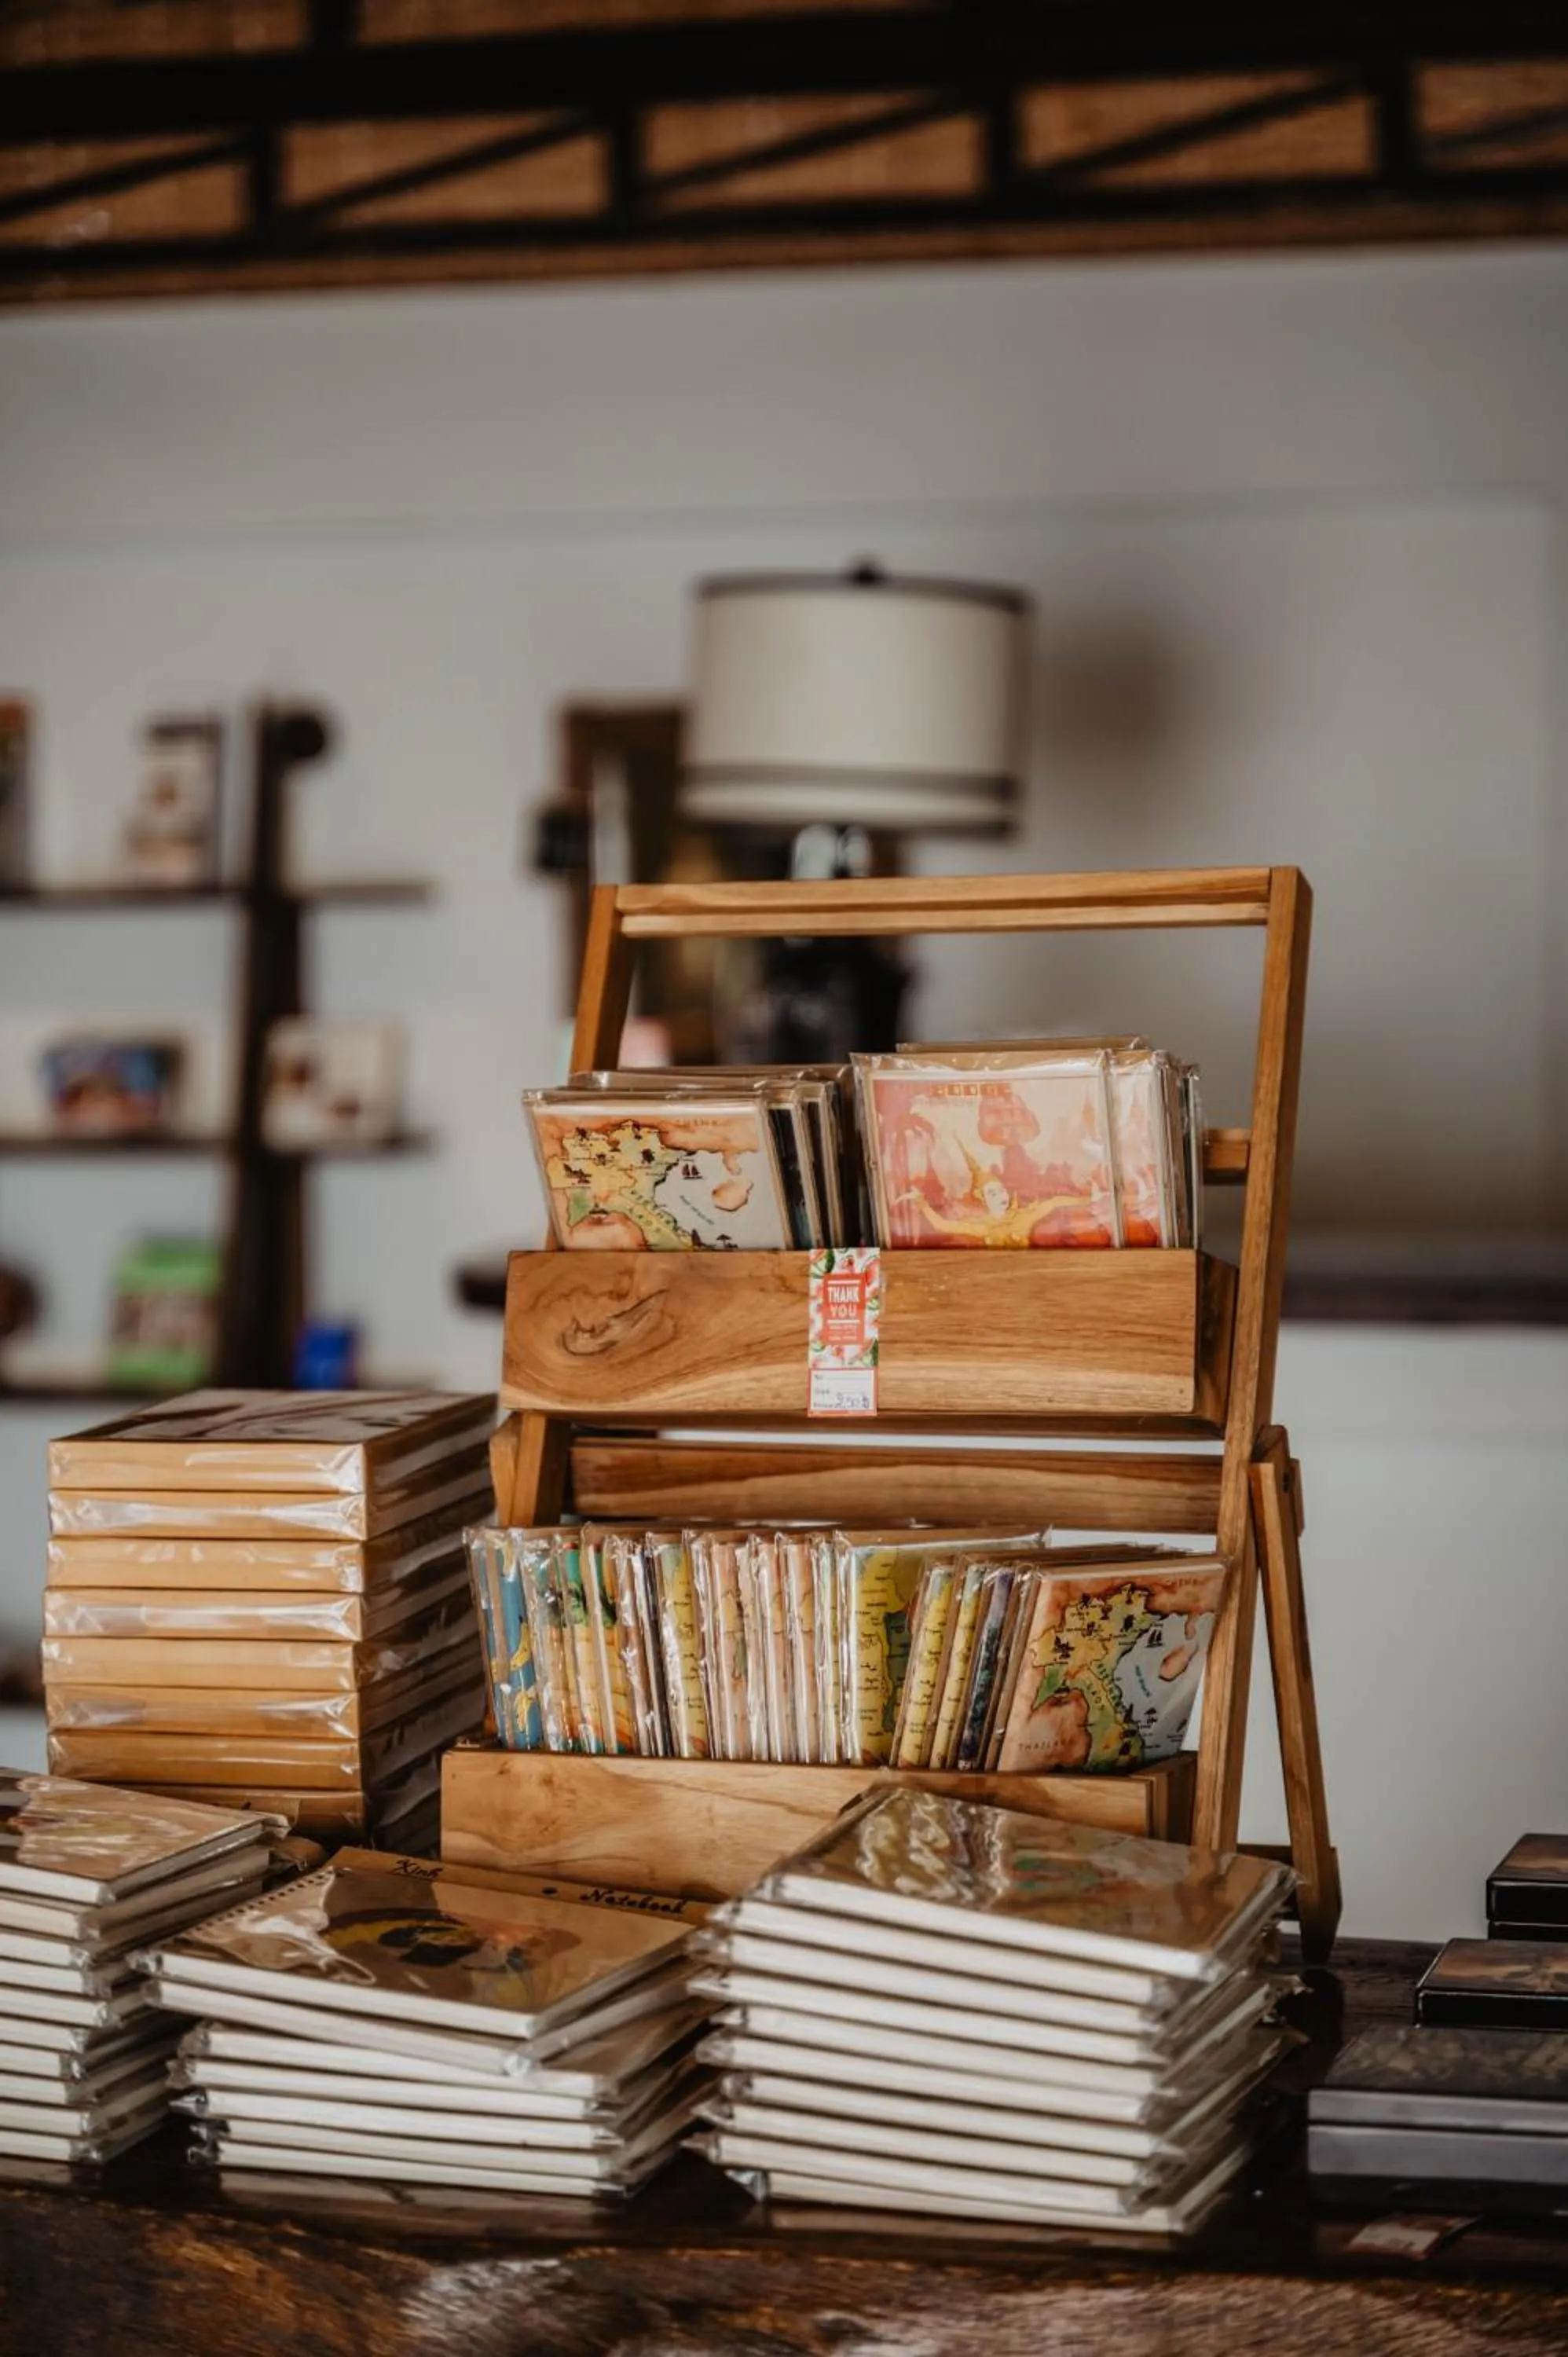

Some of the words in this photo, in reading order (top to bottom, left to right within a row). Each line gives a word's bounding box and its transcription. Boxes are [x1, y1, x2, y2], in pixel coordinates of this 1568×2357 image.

[827, 1285, 860, 1303] THANK
[830, 1303, 858, 1319] YOU
[579, 1887, 688, 1914] Notebook
